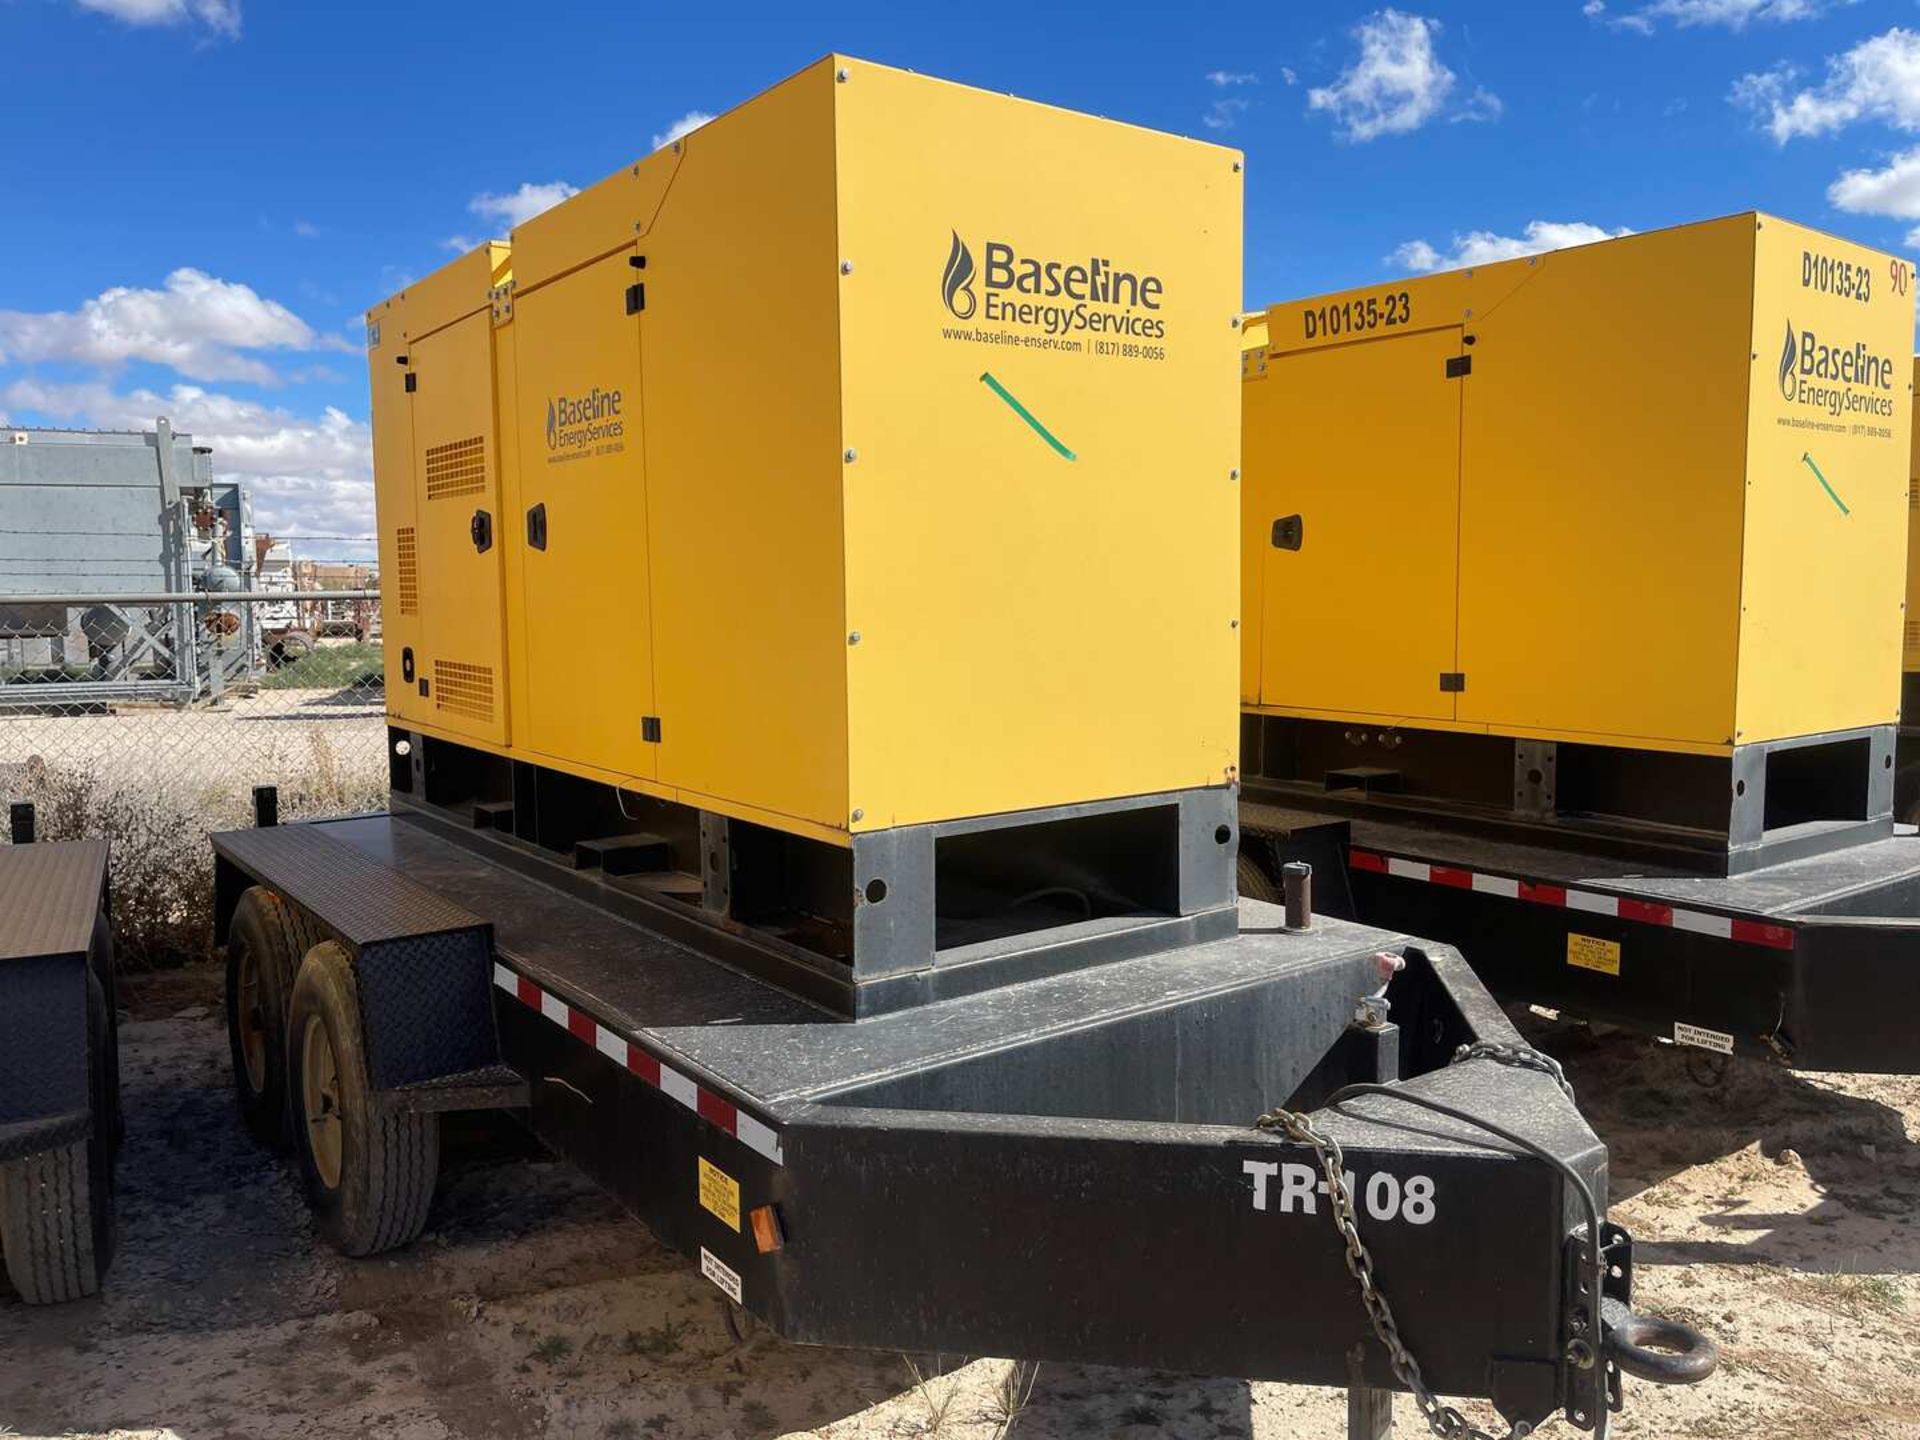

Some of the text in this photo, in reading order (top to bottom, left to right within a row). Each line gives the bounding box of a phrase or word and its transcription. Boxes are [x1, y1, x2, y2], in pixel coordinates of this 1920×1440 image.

[984, 241, 1163, 310] Baseline
[1802, 250, 1871, 303] D10135-23
[1889, 259, 1908, 297] 90
[1303, 292, 1411, 340] D10135-23
[942, 327, 1165, 361] www.baseline-enserv.com (817) 889-0056
[1800, 331, 1893, 390] Baseline
[558, 387, 622, 428] Baseline
